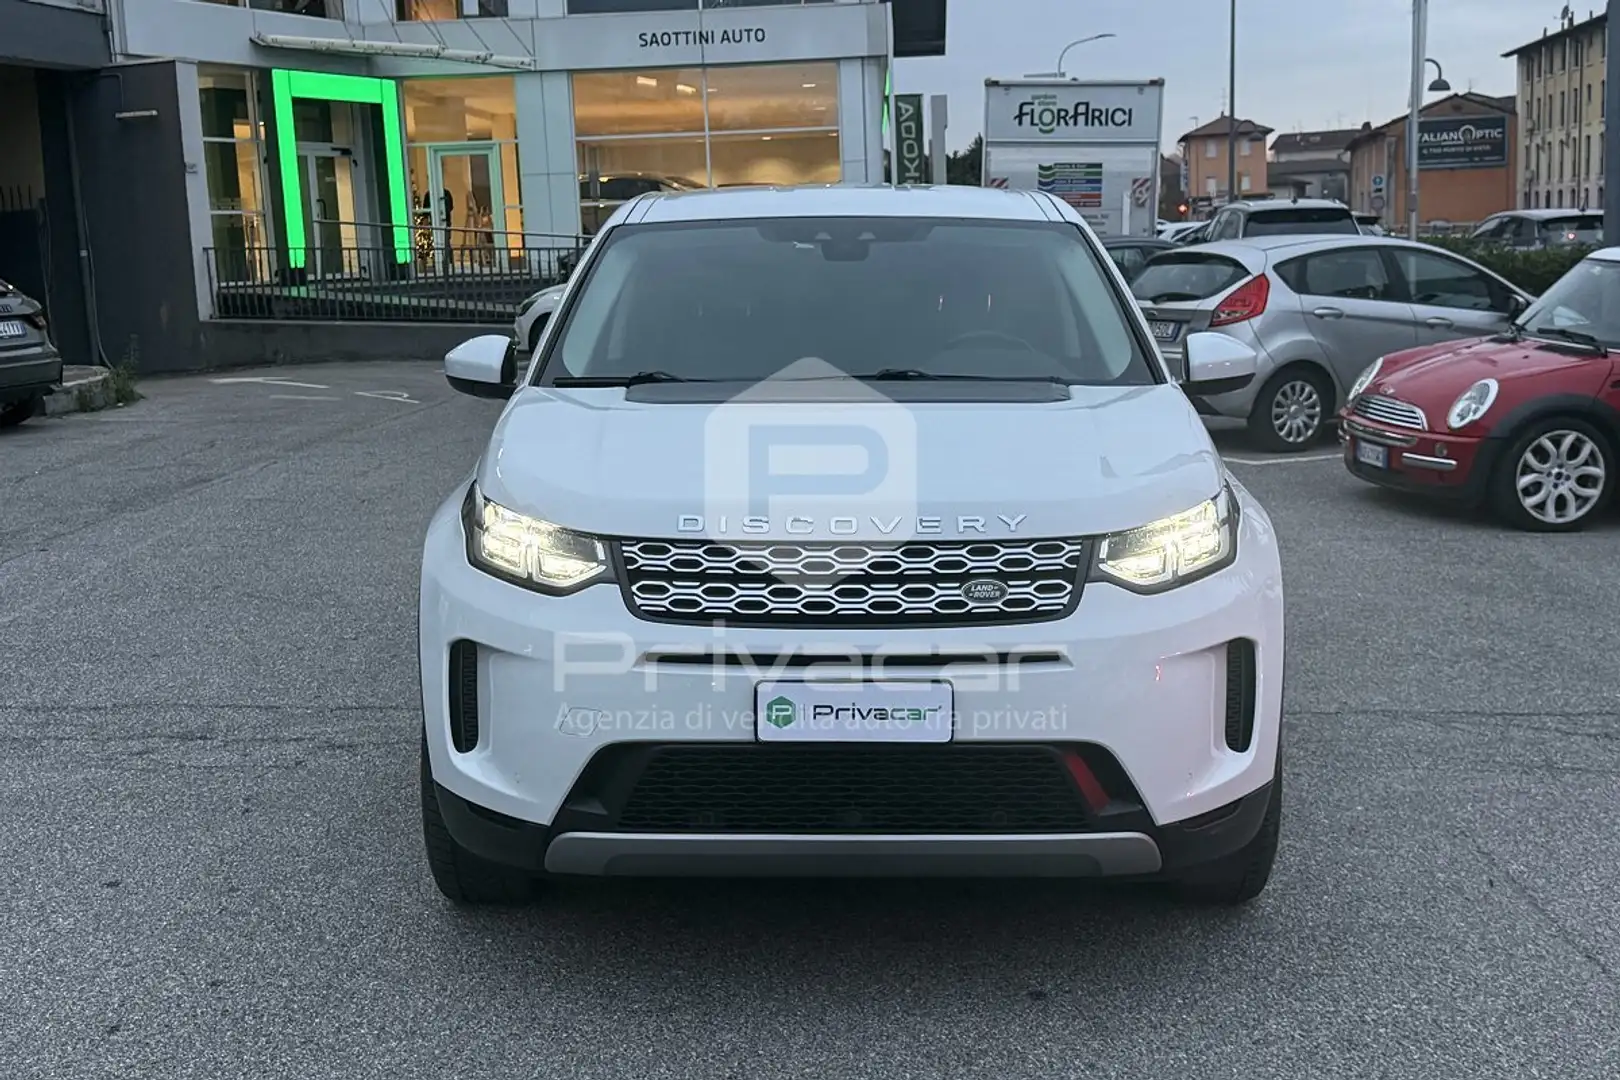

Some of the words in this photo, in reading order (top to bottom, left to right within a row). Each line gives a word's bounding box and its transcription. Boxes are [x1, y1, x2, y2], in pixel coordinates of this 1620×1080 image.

[638, 30, 715, 48] SAOTTINI
[719, 28, 766, 44] AUTO
[676, 513, 1028, 535] DISCOVERY
[812, 702, 942, 721] Privacar
